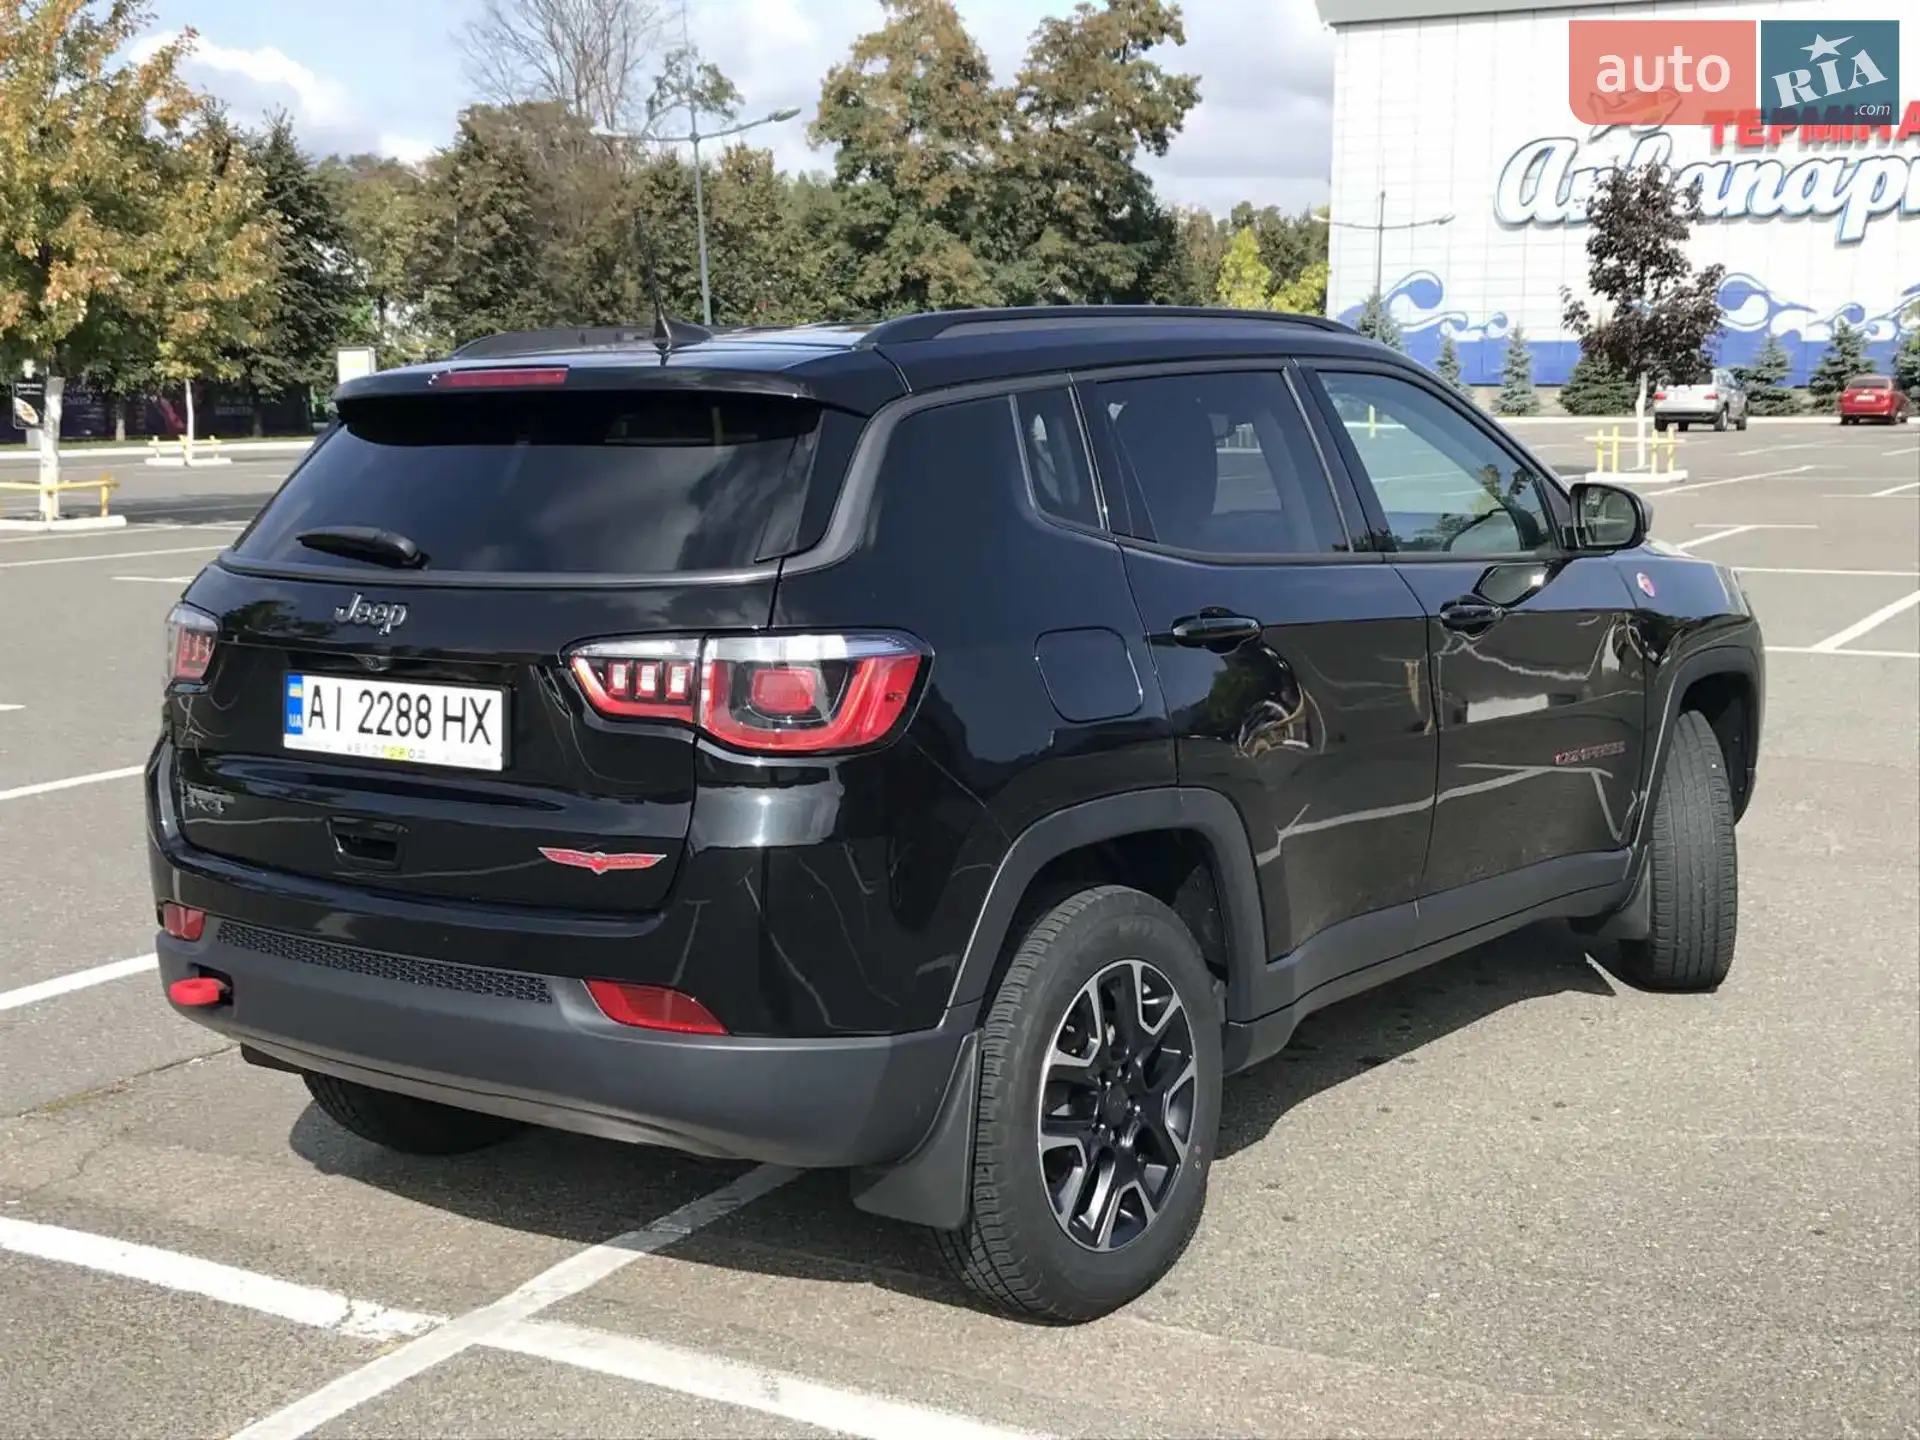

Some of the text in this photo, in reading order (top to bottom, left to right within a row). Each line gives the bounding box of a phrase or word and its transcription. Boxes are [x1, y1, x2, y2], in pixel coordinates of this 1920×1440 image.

[334, 592, 408, 635] Jeep
[307, 684, 492, 746] AI 2288 HX
